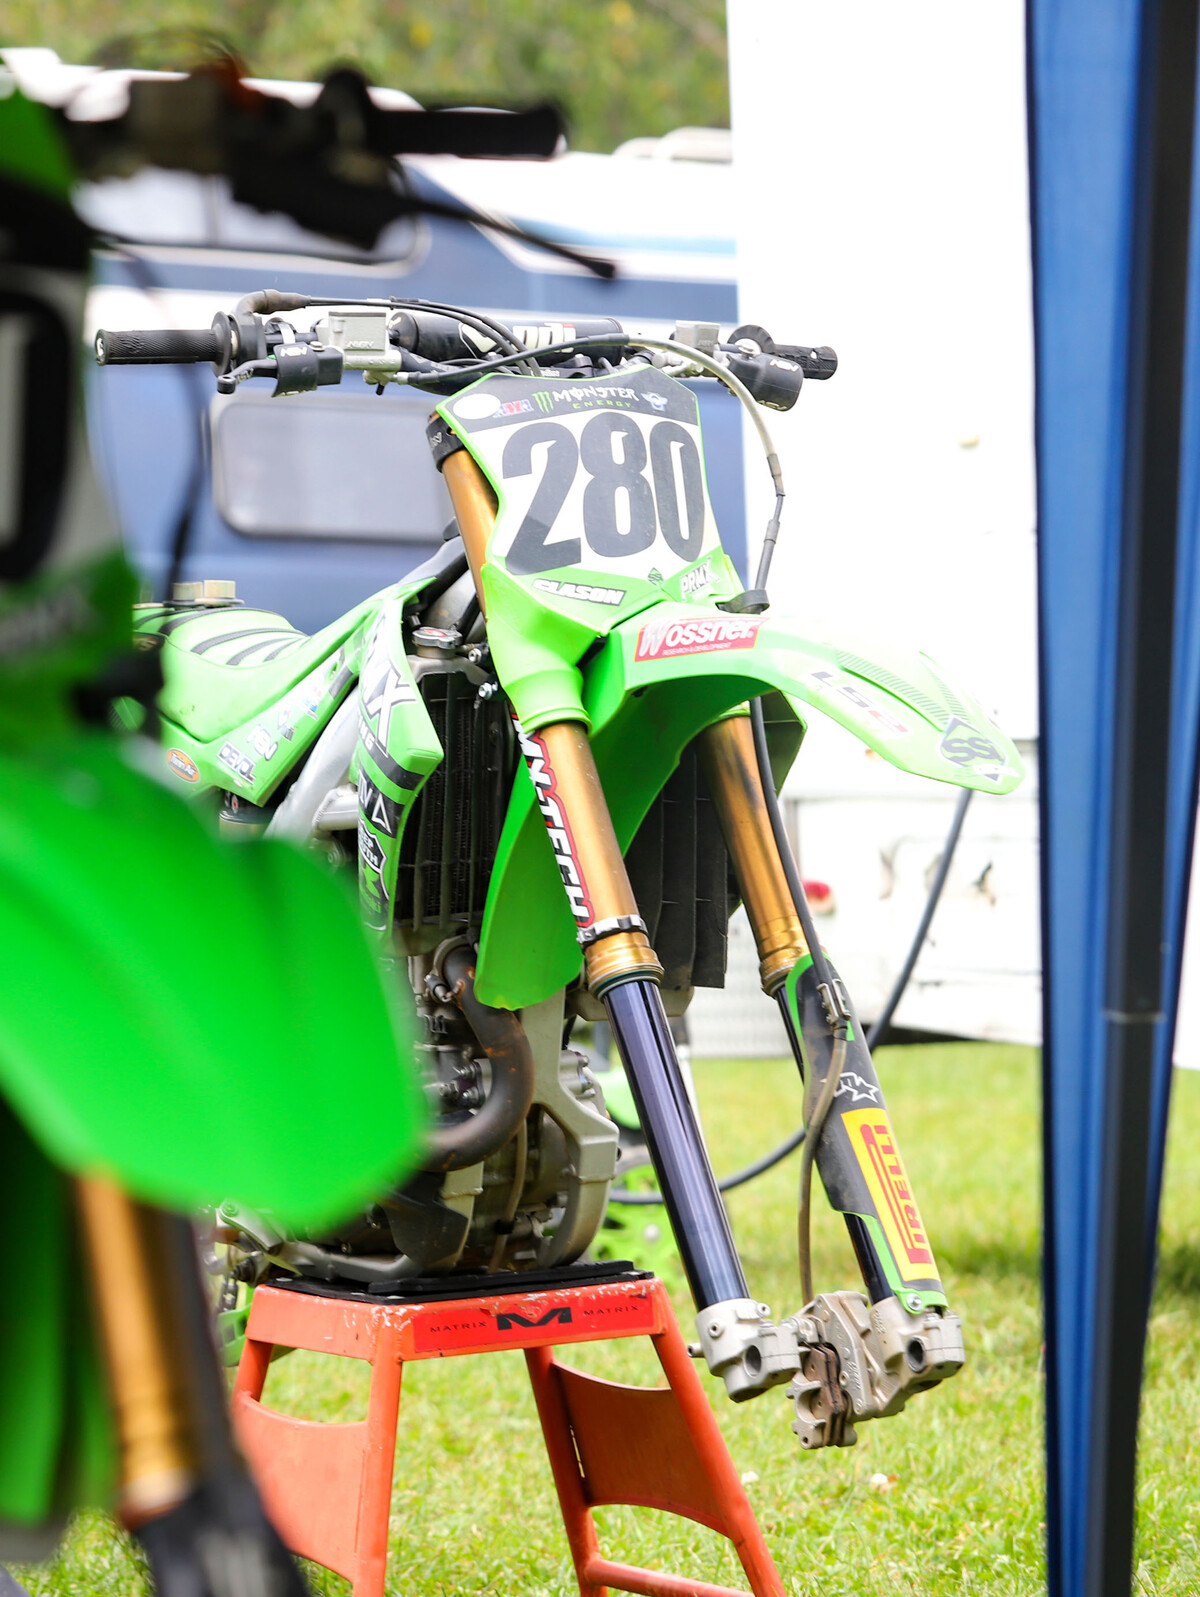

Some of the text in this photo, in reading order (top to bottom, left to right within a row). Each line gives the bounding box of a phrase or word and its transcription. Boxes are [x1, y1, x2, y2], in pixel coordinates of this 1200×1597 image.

[552, 386, 640, 403] MONSTER
[572, 399, 632, 409] ENERGY
[502, 411, 705, 576] 280
[533, 578, 626, 606] CLASON
[859, 1122, 932, 1265] PIRELLI
[429, 1321, 487, 1333] MATRIX
[583, 1305, 639, 1317] MATRIX
